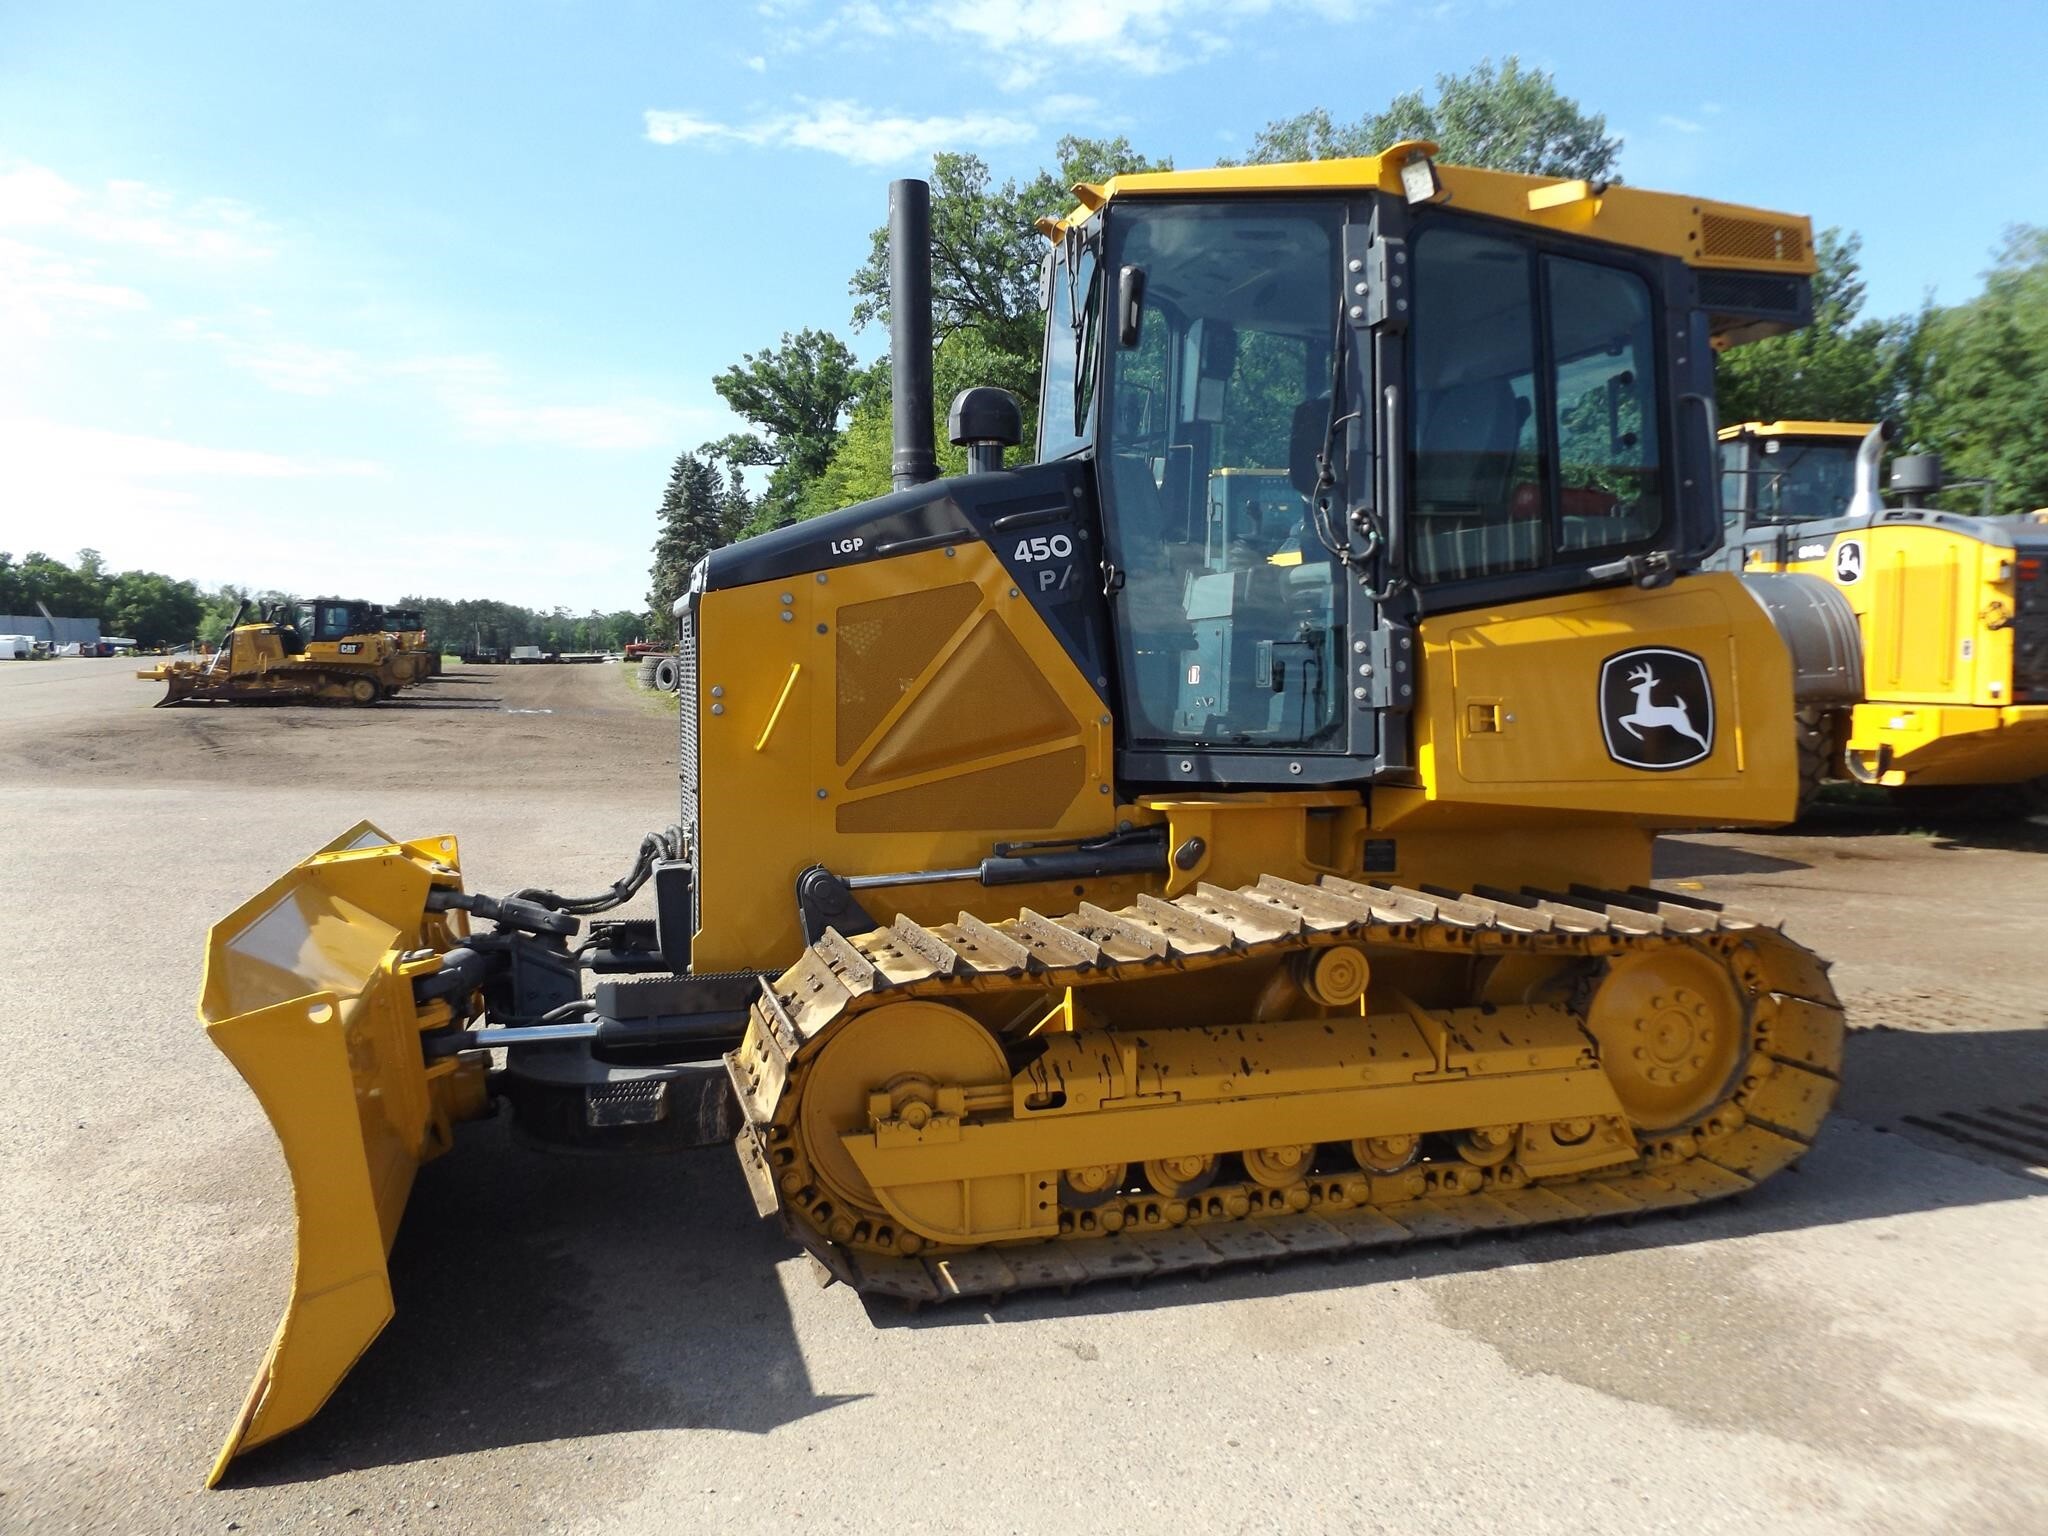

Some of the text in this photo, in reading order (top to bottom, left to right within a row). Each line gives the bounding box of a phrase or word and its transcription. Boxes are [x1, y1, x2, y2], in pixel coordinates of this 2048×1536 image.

[831, 537, 864, 555] LGP
[1014, 534, 1073, 563] 450
[341, 644, 357, 654] CAT
